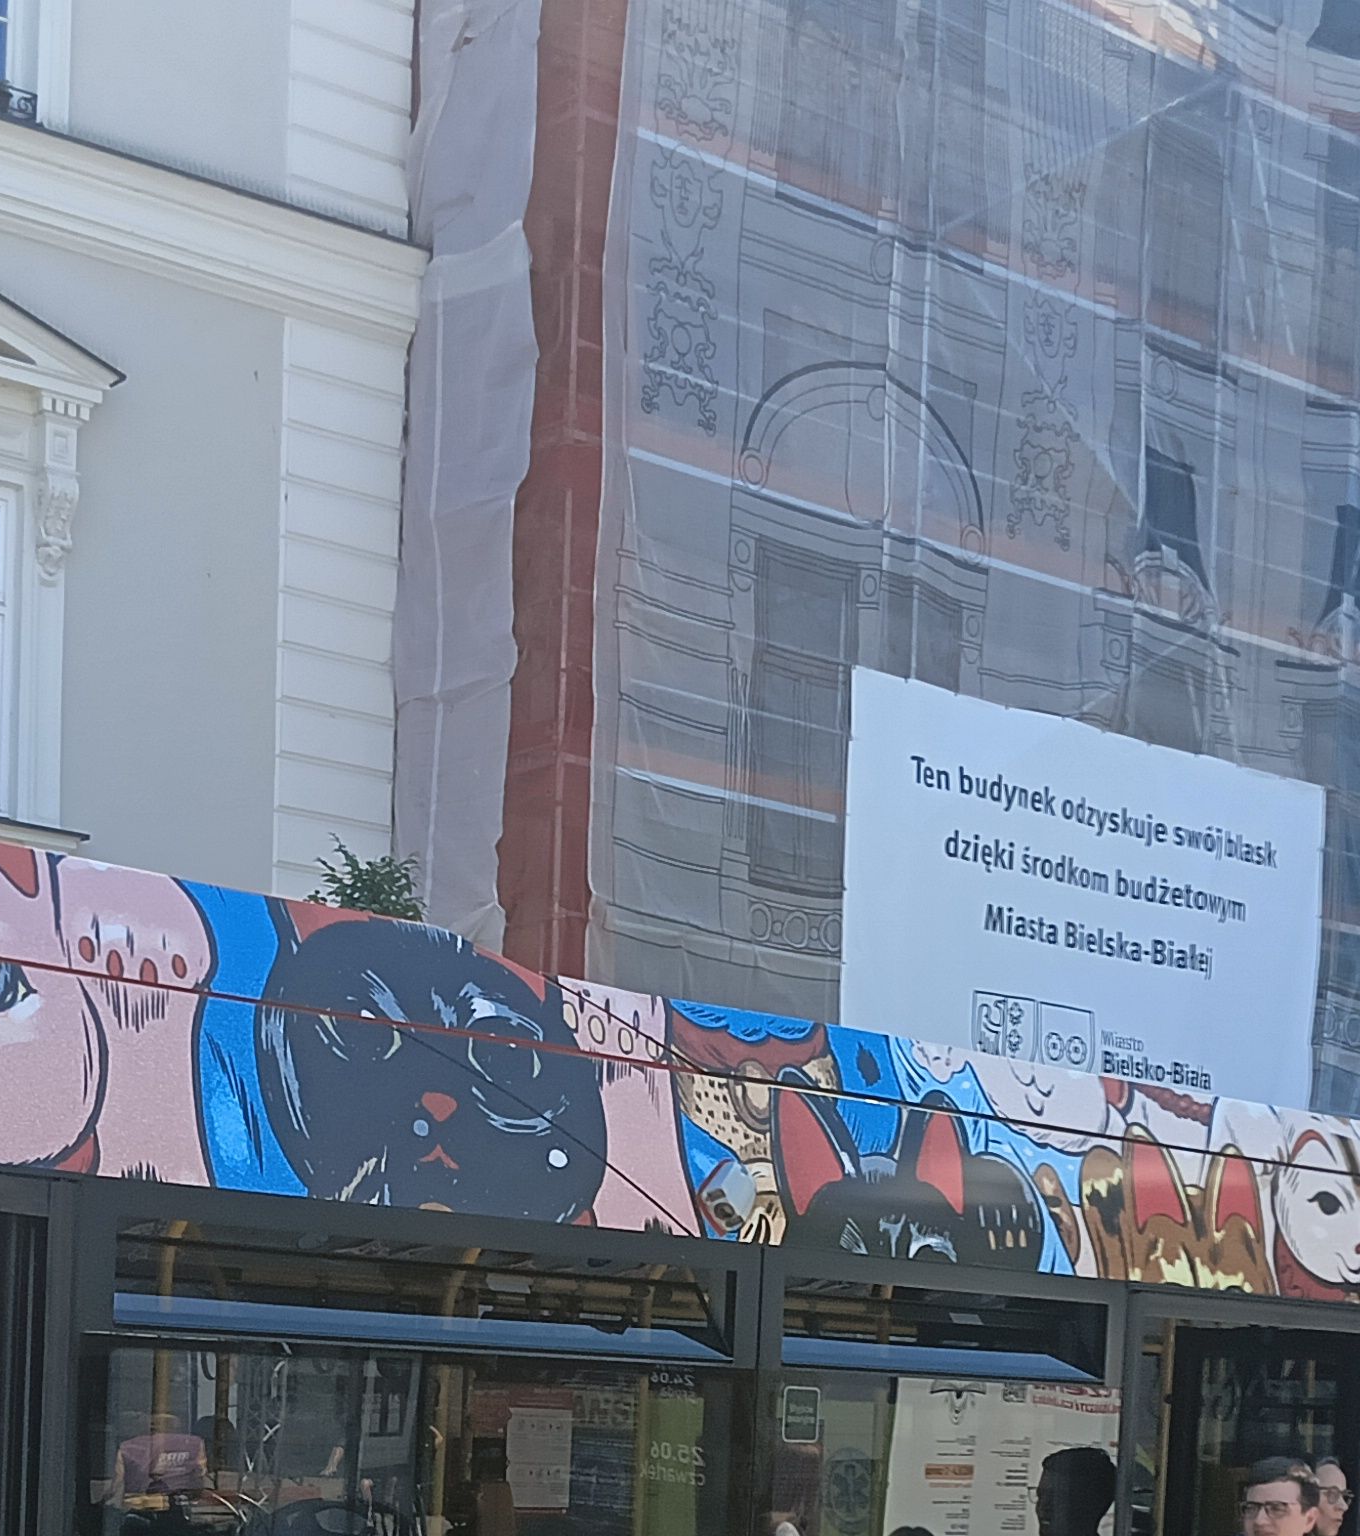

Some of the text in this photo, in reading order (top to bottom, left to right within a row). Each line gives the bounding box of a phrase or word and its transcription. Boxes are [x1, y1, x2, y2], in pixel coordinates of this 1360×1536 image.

[910, 755, 1277, 868] Ten budynek odzyskuje swój blask
[944, 829, 1246, 923] dzięki środkom budżetowym
[984, 903, 1213, 980] Miasta Bielska-Białej
[1101, 1029, 1144, 1052] Miasto
[1103, 1050, 1211, 1090] Bielsko-Biała
